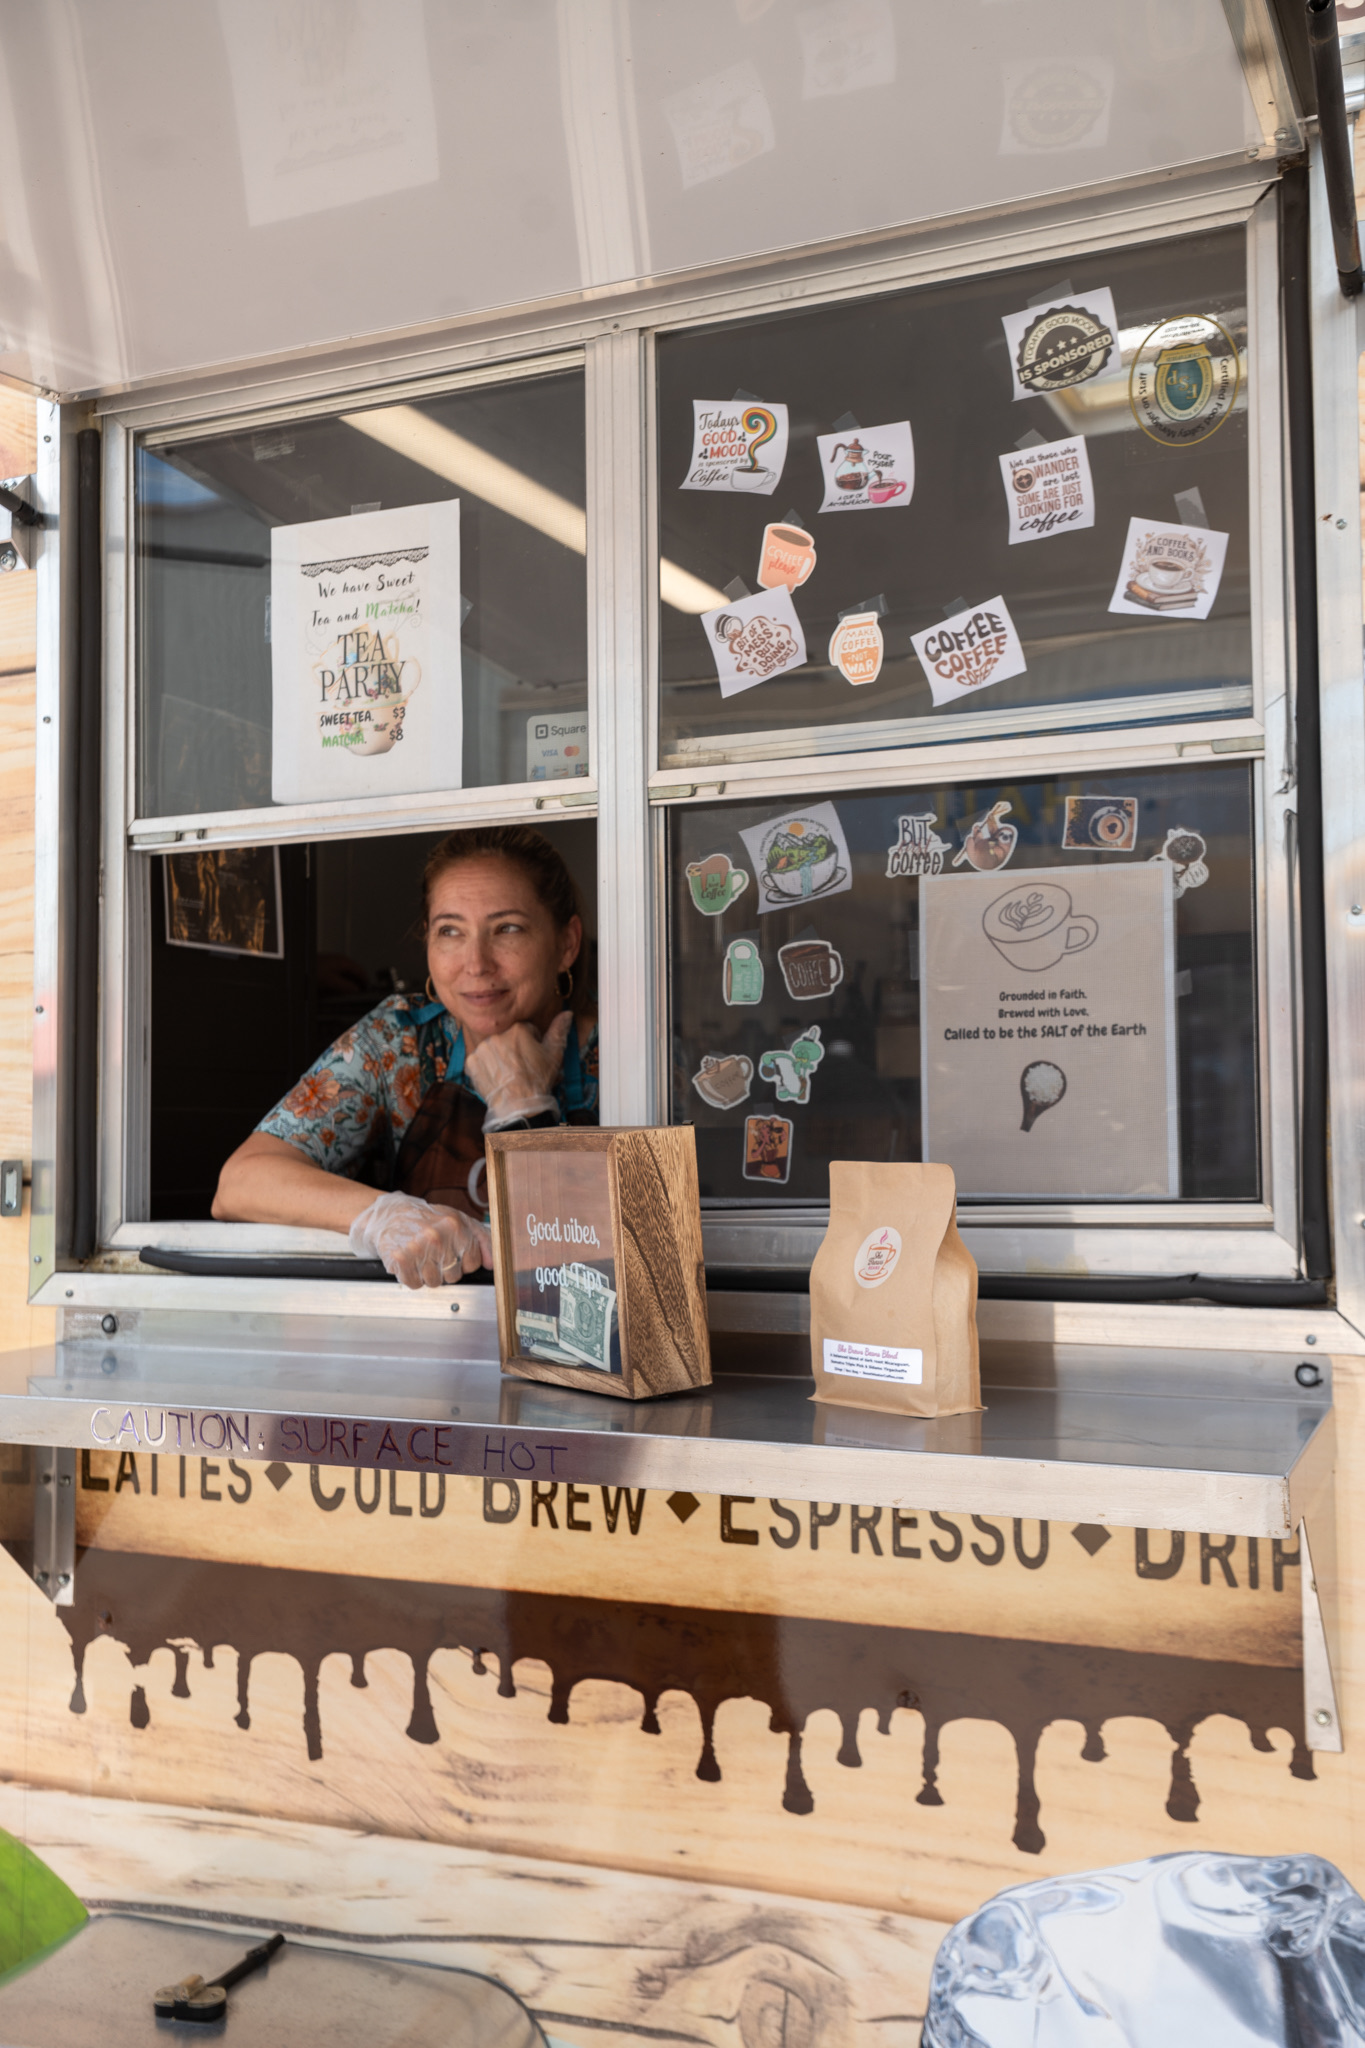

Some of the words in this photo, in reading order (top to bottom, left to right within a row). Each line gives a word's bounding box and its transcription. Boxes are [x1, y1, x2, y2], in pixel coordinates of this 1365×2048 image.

[1045, 315, 1070, 329] GOOD
[1072, 316, 1095, 334] MOOD
[1019, 369, 1033, 382] IS
[1033, 333, 1113, 376] SPONSORED
[1138, 371, 1147, 395] Staff
[1218, 357, 1230, 401] Certified
[1140, 396, 1150, 410] on
[1204, 401, 1223, 426] Food
[1146, 411, 1176, 439] Manager
[702, 429, 737, 446] GOOD
[709, 443, 747, 459] MOOD
[1009, 459, 1024, 469] Not
[1025, 456, 1036, 465] all
[1037, 451, 1058, 462] those
[1060, 446, 1077, 456] who
[690, 468, 730, 487] Coffee
[1033, 456, 1080, 479] WANDER
[1042, 478, 1060, 487] are
[1061, 471, 1080, 482] lost
[1016, 490, 1041, 507] SOME
[1042, 486, 1060, 501] ARE
[1062, 480, 1082, 496] JUST
[1018, 498, 1062, 519] LOOKING
[1063, 493, 1084, 509] FOR
[1019, 509, 1084, 533] coffee
[1145, 545, 1165, 556] AND
[1167, 548, 1195, 563] BOOKS
[1157, 537, 1188, 550] COFFEE
[767, 545, 804, 567] COFFEE
[318, 581, 338, 599] We
[342, 581, 372, 594] have
[376, 570, 416, 592] Sweet
[312, 609, 331, 628] Tea
[336, 606, 358, 623] and
[748, 624, 758, 638] OF
[845, 627, 875, 639] MAKE
[924, 611, 1006, 663] COFFEE
[337, 629, 388, 666] TEA
[744, 628, 774, 657] MESS
[755, 640, 775, 658] BUT
[841, 636, 877, 651] COFFEE
[758, 640, 786, 668] DOING
[851, 650, 869, 662] NOT
[934, 633, 1008, 679] COFFEE
[845, 658, 874, 675] WAR
[320, 660, 407, 703] PARTY
[320, 711, 352, 728] SWEET
[354, 710, 375, 724] TEA.
[392, 706, 406, 720] $3
[389, 728, 404, 742] $8
[551, 725, 587, 737] Square
[901, 818, 932, 847] BUT
[999, 989, 1046, 1002] Grounded
[1048, 988, 1057, 1000] in
[1060, 988, 1088, 1000] Faith.
[998, 1007, 1036, 1019] Brewed
[1038, 1006, 1061, 1018] with
[1063, 1006, 1089, 1018] Love.
[944, 1026, 980, 1041] Called
[983, 1026, 996, 1040] to
[999, 1026, 1014, 1039] be
[1017, 1025, 1038, 1038] the
[1041, 1024, 1068, 1039] SALT
[1070, 1024, 1084, 1037] of
[1087, 1023, 1108, 1037] the
[1111, 1022, 1147, 1036] Earth
[526, 1213, 563, 1247] Good
[563, 1217, 601, 1249] vibes,
[535, 1262, 570, 1293] good
[570, 1261, 604, 1298] Tips
[91, 1406, 266, 1453] CAUTION:
[280, 1415, 454, 1467] SURFACE
[483, 1434, 568, 1475] HOT
[482, 1476, 647, 1536] BREW
